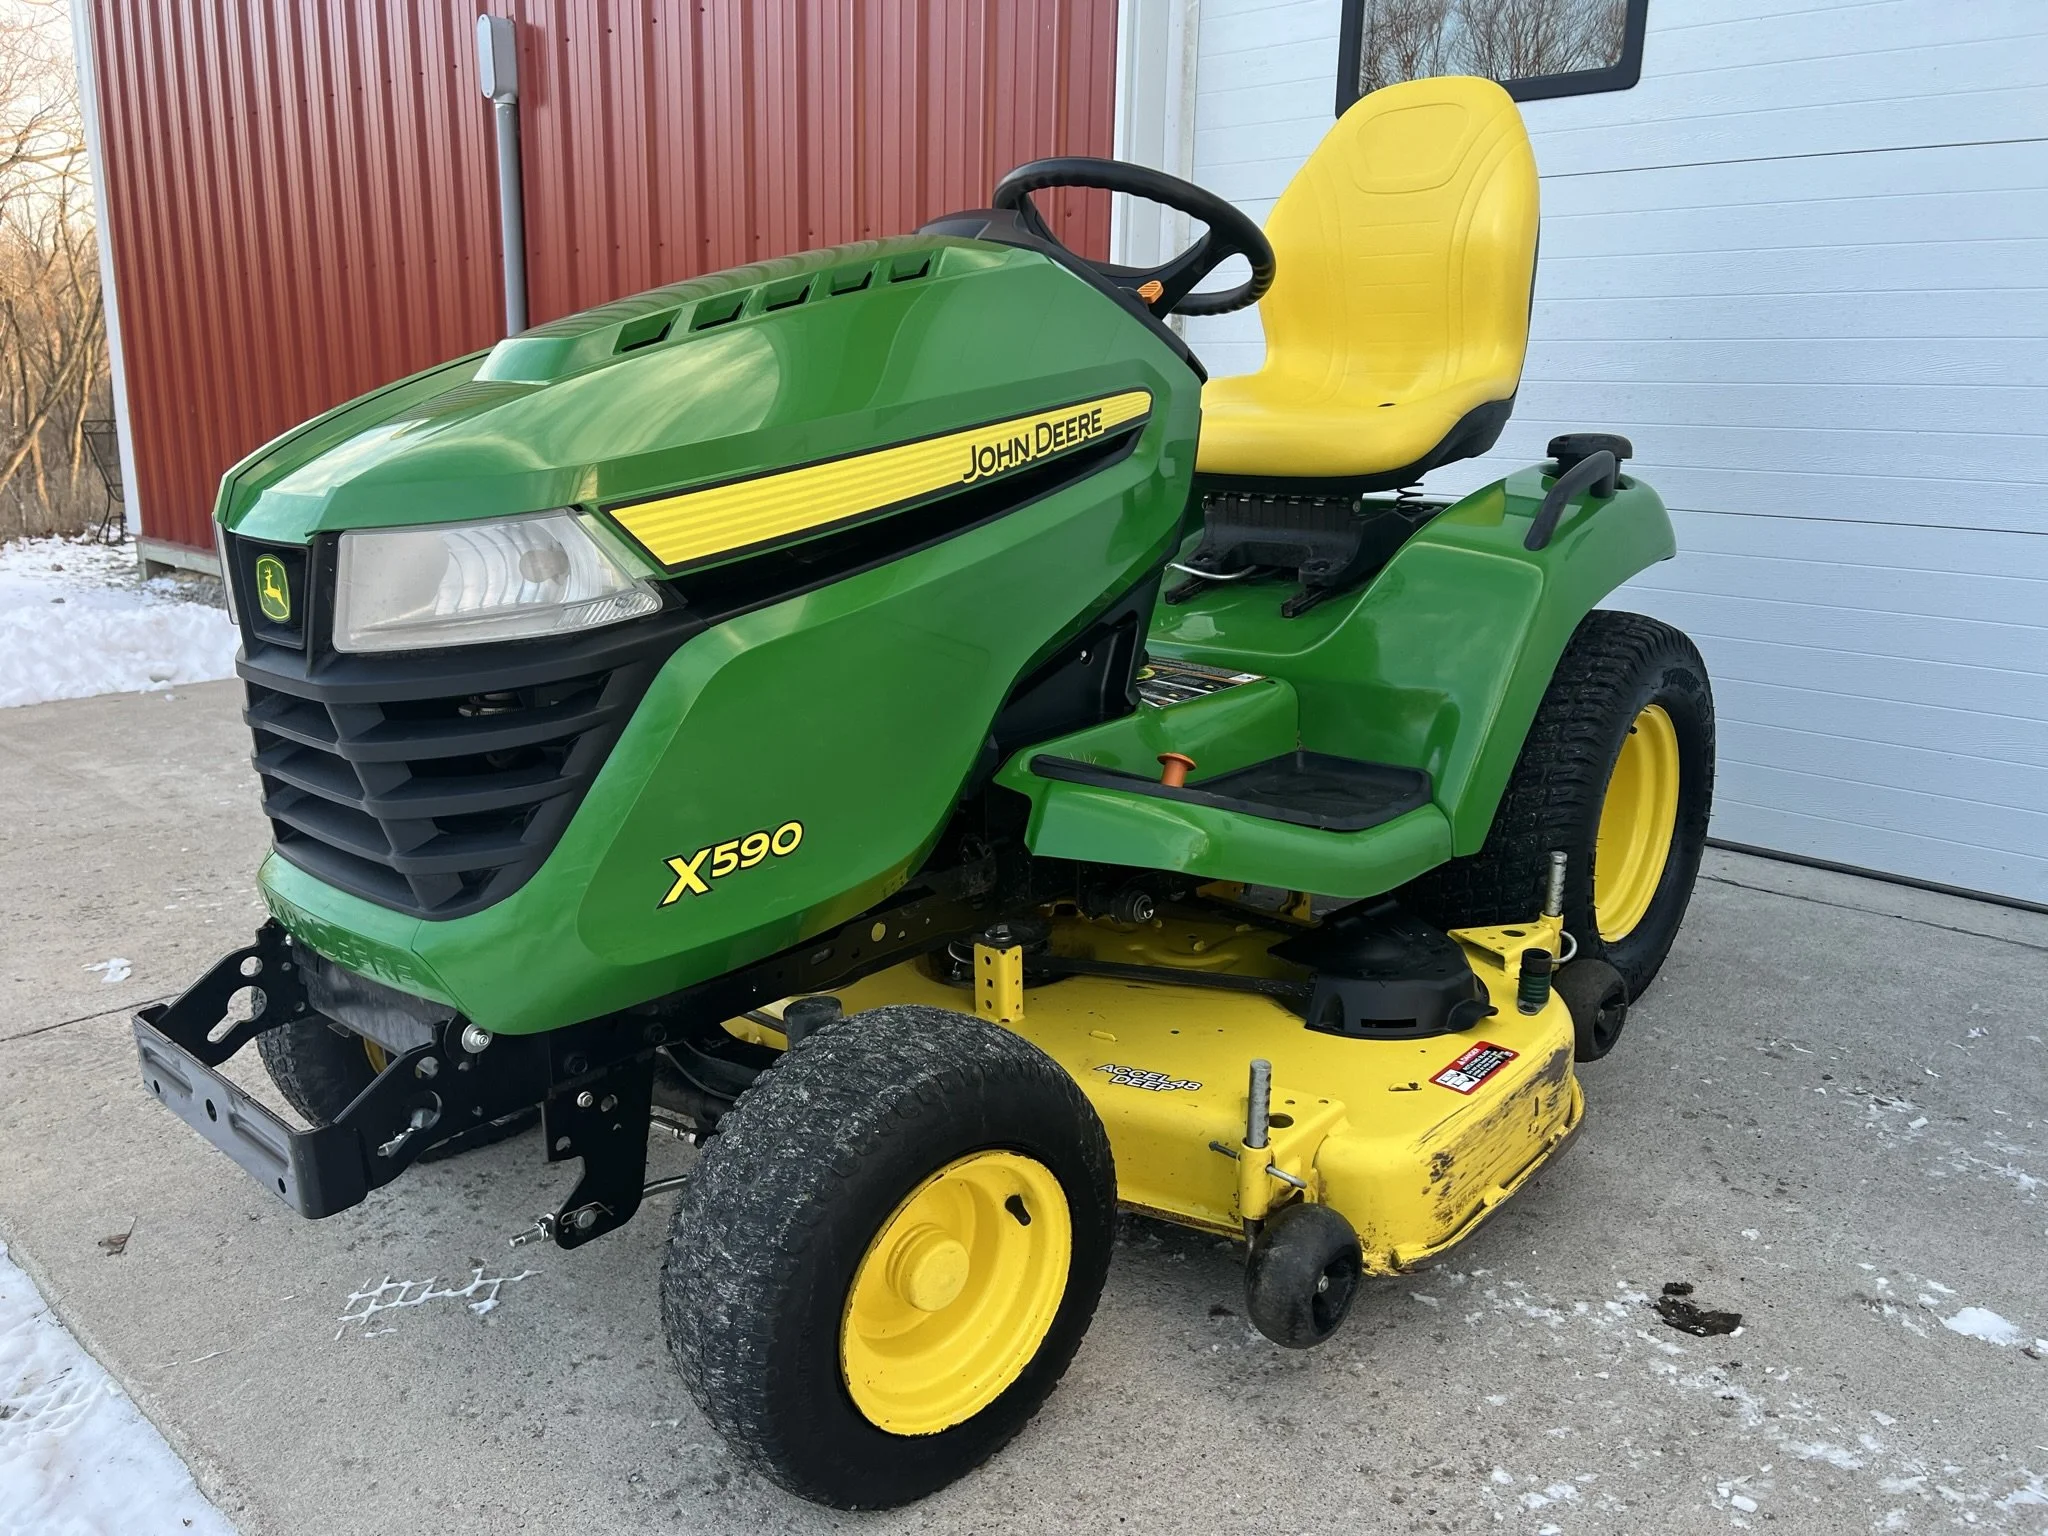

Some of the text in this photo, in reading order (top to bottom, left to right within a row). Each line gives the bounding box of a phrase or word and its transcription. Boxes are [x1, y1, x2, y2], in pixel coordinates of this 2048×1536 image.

[963, 407, 1103, 482] JOHN DEERE
[656, 820, 804, 909] X590
[1093, 1064, 1203, 1091] ACCEL 48
[1108, 1074, 1177, 1092] DEEP
